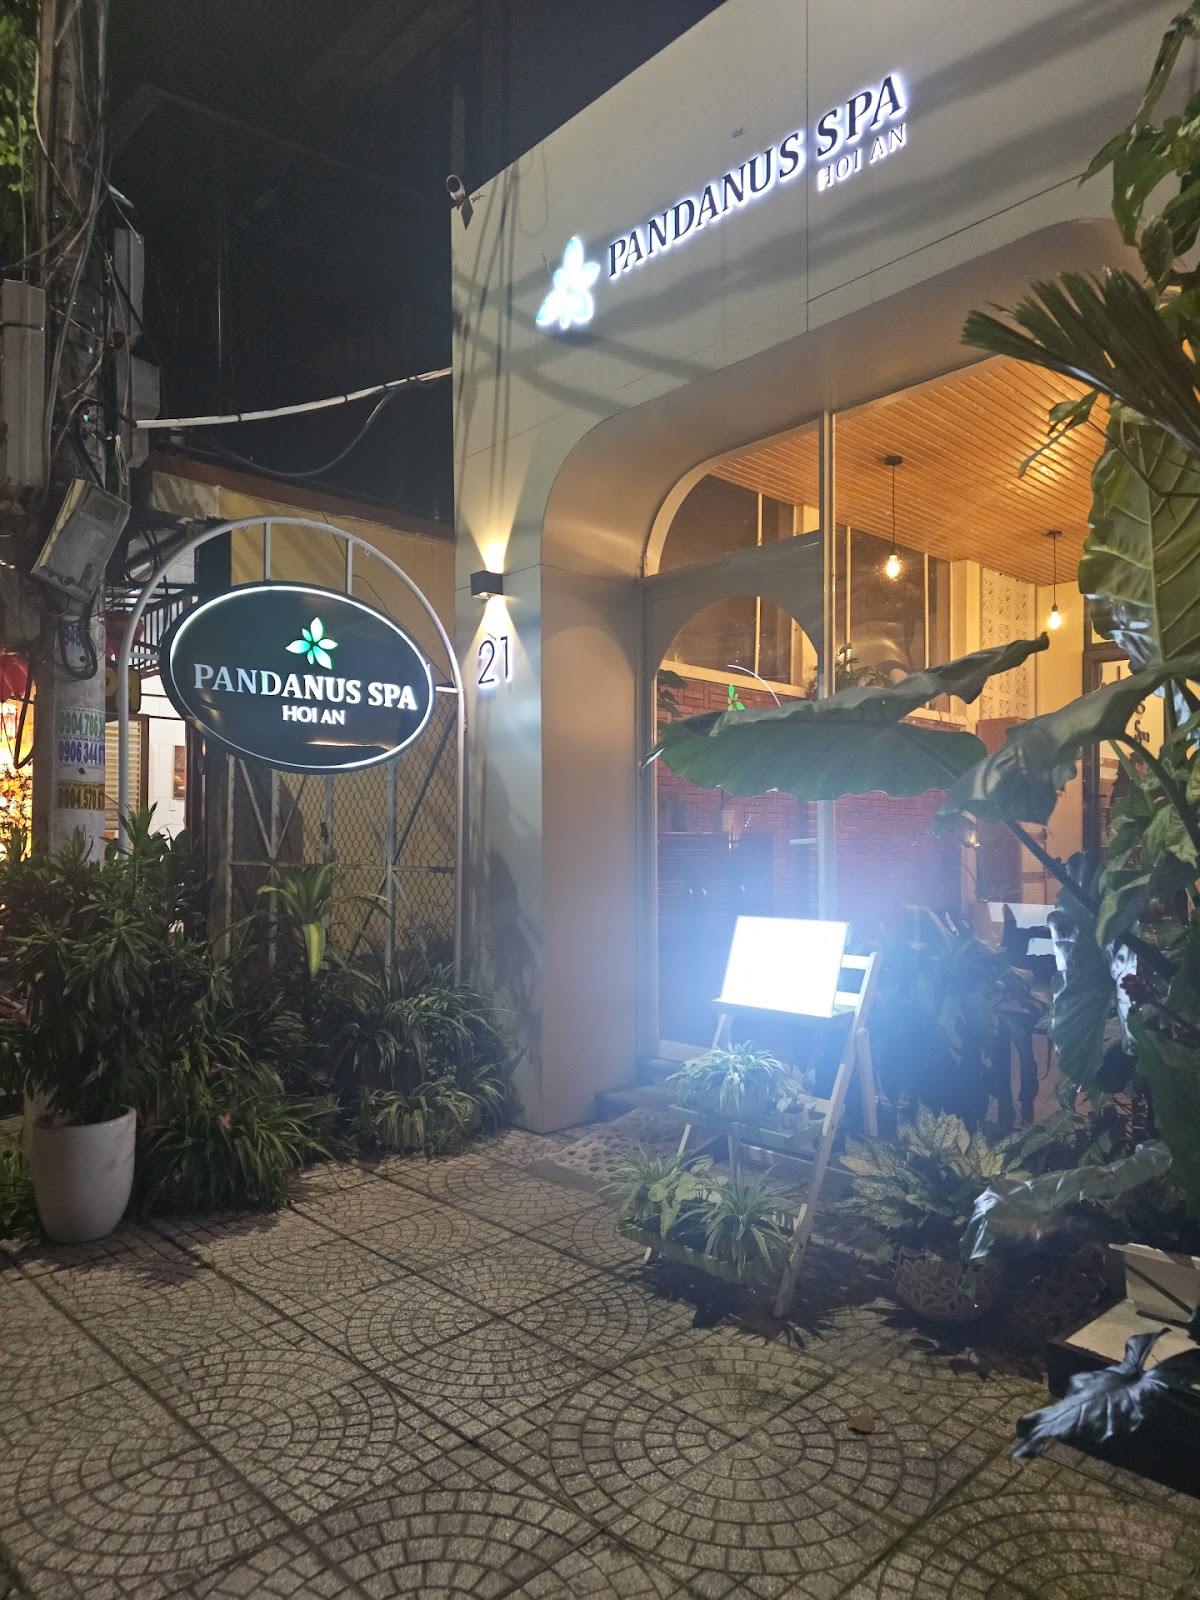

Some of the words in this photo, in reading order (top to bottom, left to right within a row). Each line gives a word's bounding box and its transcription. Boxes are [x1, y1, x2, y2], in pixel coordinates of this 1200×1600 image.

[607, 132, 803, 278] PANDANUS
[816, 75, 905, 158] SPA
[817, 149, 863, 191] HOI
[869, 123, 907, 163] AN
[478, 635, 508, 684] 21
[193, 663, 362, 705] PANDANUS
[367, 681, 418, 711] SPA
[282, 704, 317, 724] HOI
[320, 708, 346, 726] AN
